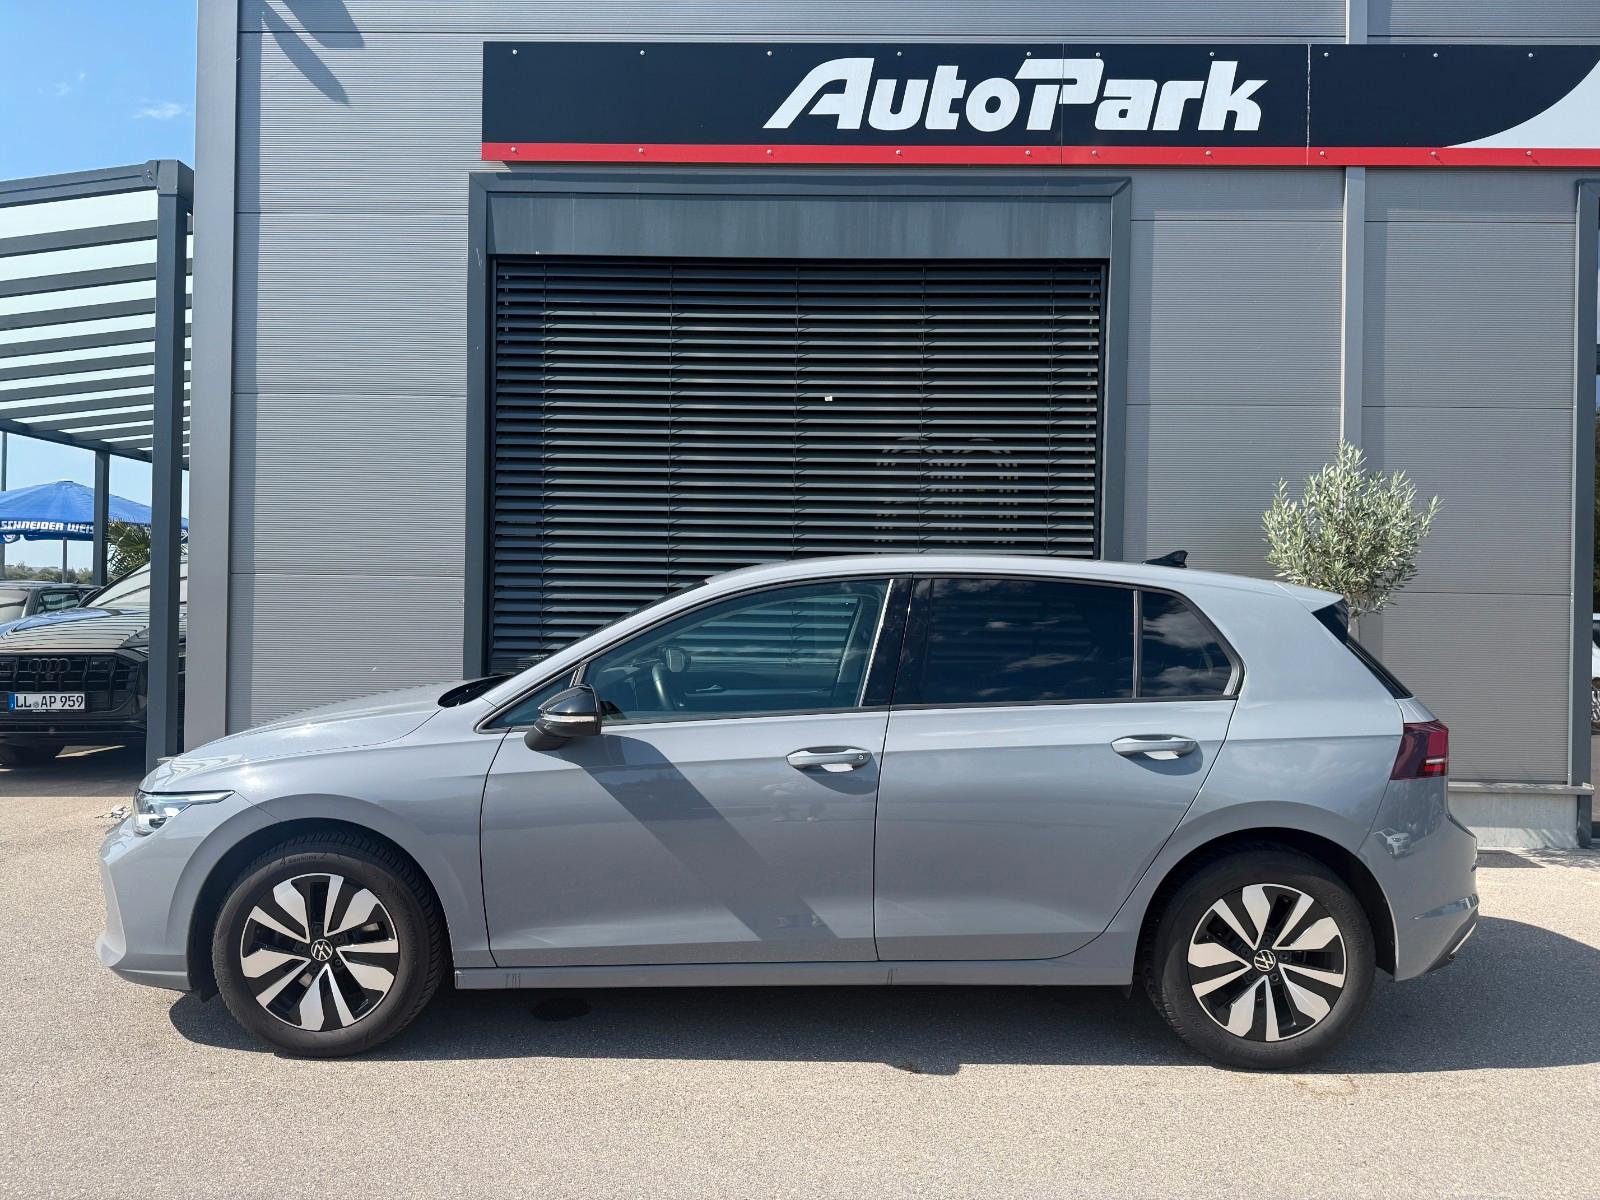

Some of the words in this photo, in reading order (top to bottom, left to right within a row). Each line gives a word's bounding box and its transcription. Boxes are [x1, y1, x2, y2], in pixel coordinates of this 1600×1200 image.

[762, 57, 1268, 133] AutoPark
[0, 520, 64, 531] SCHNEIDER
[15, 695, 32, 708] LL
[40, 695, 57, 708] AP
[60, 695, 84, 708] 959
